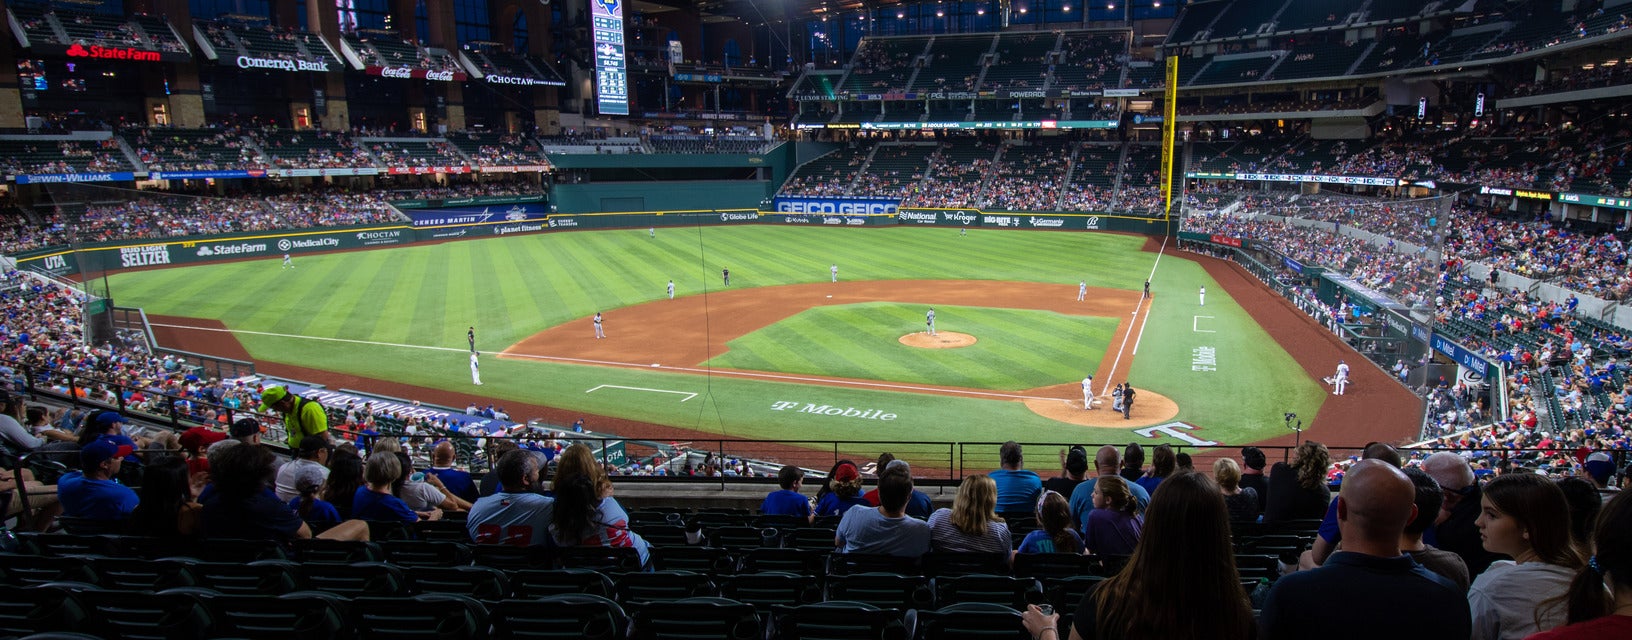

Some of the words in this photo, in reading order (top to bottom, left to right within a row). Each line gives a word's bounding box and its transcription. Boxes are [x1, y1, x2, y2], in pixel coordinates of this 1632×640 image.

[298, 60, 329, 71] Bank
[491, 75, 534, 85] CHOCTAW
[778, 201, 835, 214] GEICO
[840, 203, 900, 215] GEICO
[907, 212, 937, 220] National
[954, 211, 977, 225] Kroger
[361, 231, 400, 239] CHOCTAW
[501, 226, 521, 234] planet
[44, 255, 66, 269] UTA
[121, 250, 171, 268] SELTZER
[797, 403, 898, 421] Mobile
